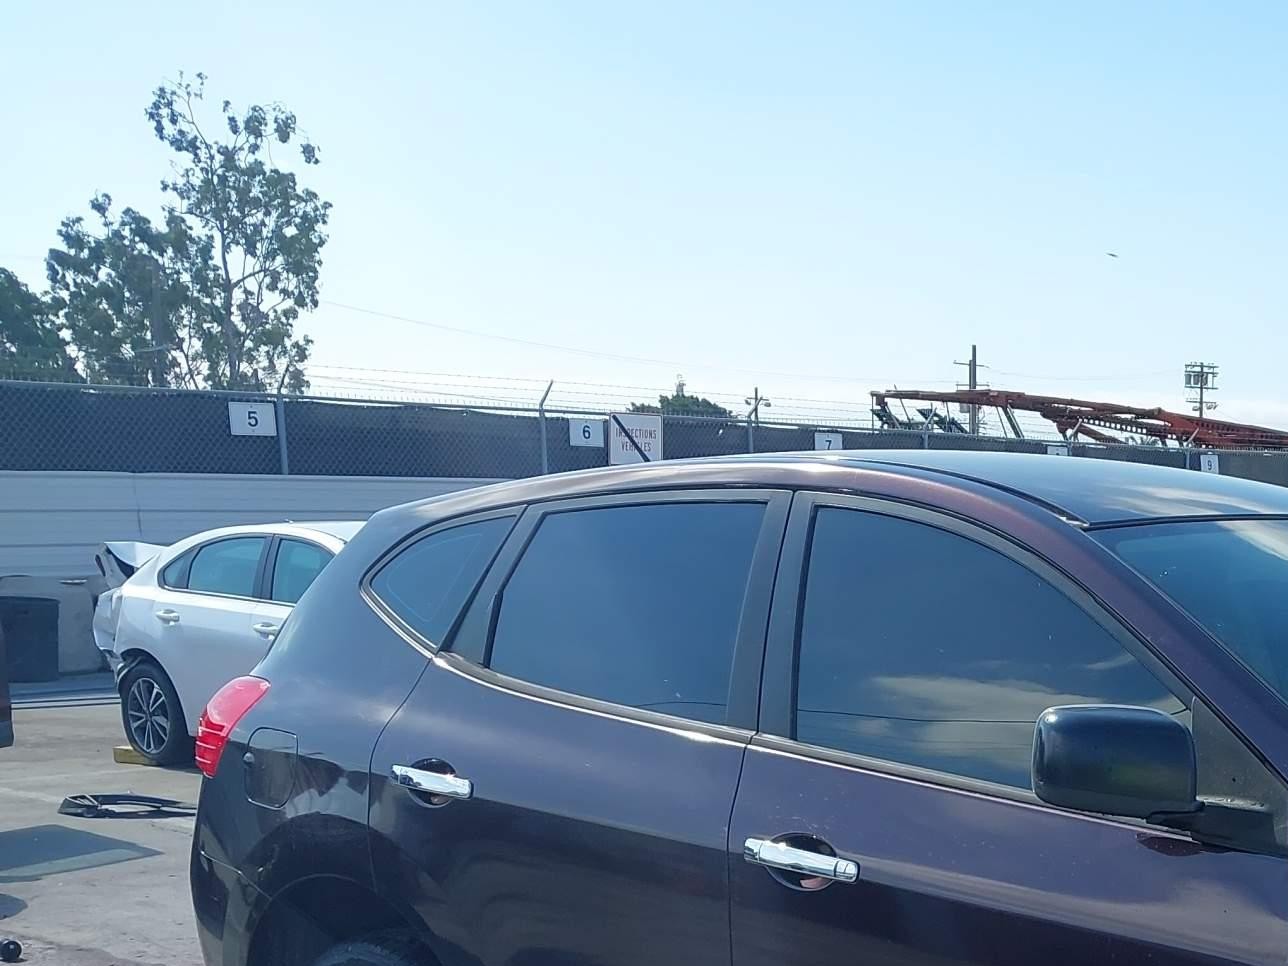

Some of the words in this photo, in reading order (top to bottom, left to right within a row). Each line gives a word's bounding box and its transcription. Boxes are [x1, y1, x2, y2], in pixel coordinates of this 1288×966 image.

[247, 410, 259, 427] 5
[582, 425, 592, 440] 6
[825, 439, 832, 450] 7
[1207, 459, 1213, 471] 9
